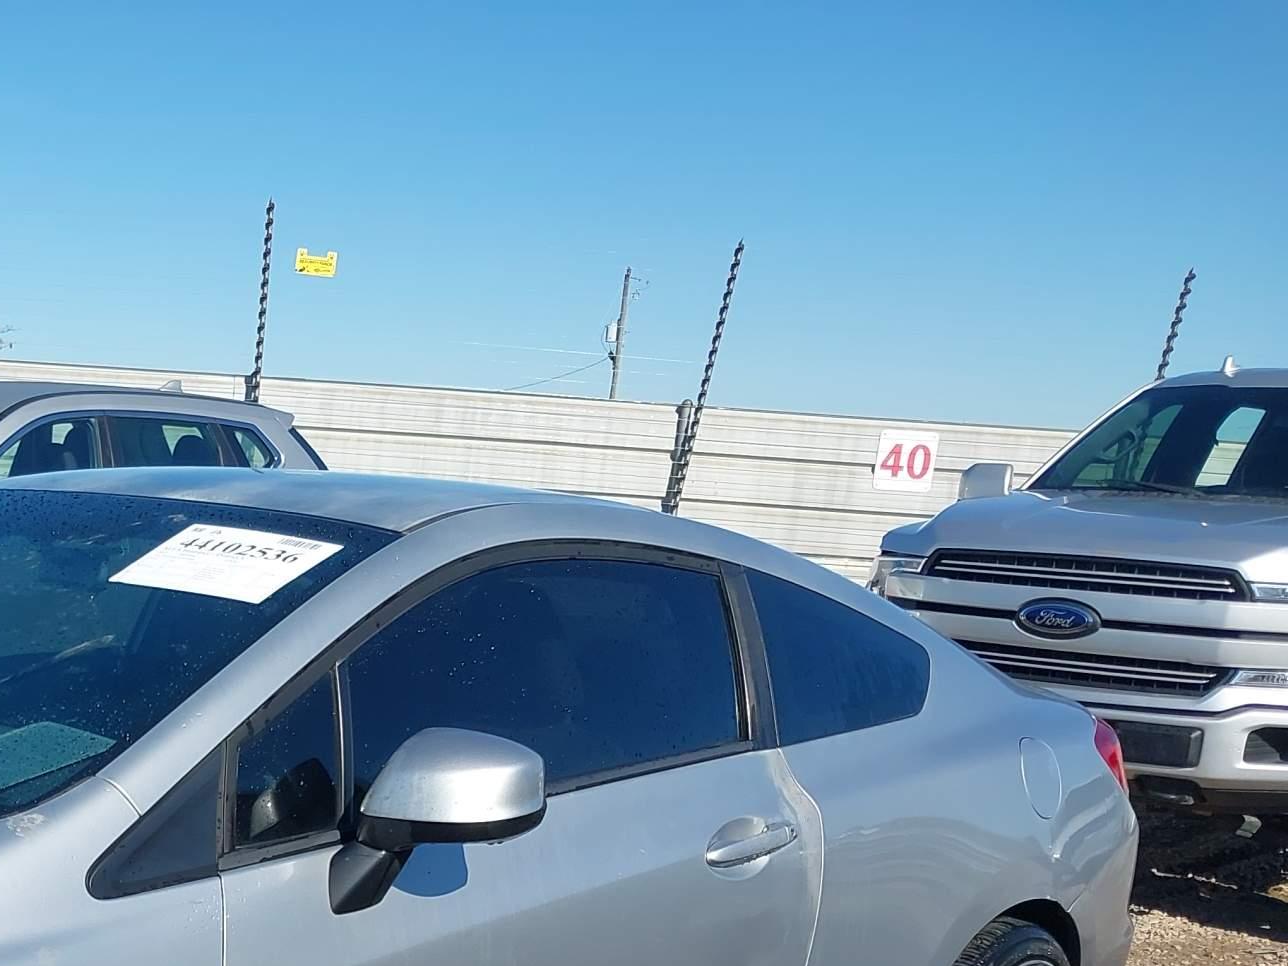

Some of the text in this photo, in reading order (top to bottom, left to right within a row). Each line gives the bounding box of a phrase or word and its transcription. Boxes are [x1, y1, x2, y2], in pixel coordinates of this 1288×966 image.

[879, 443, 932, 480] 40
[179, 537, 304, 564] 44102536
[1034, 608, 1076, 628] Ford
